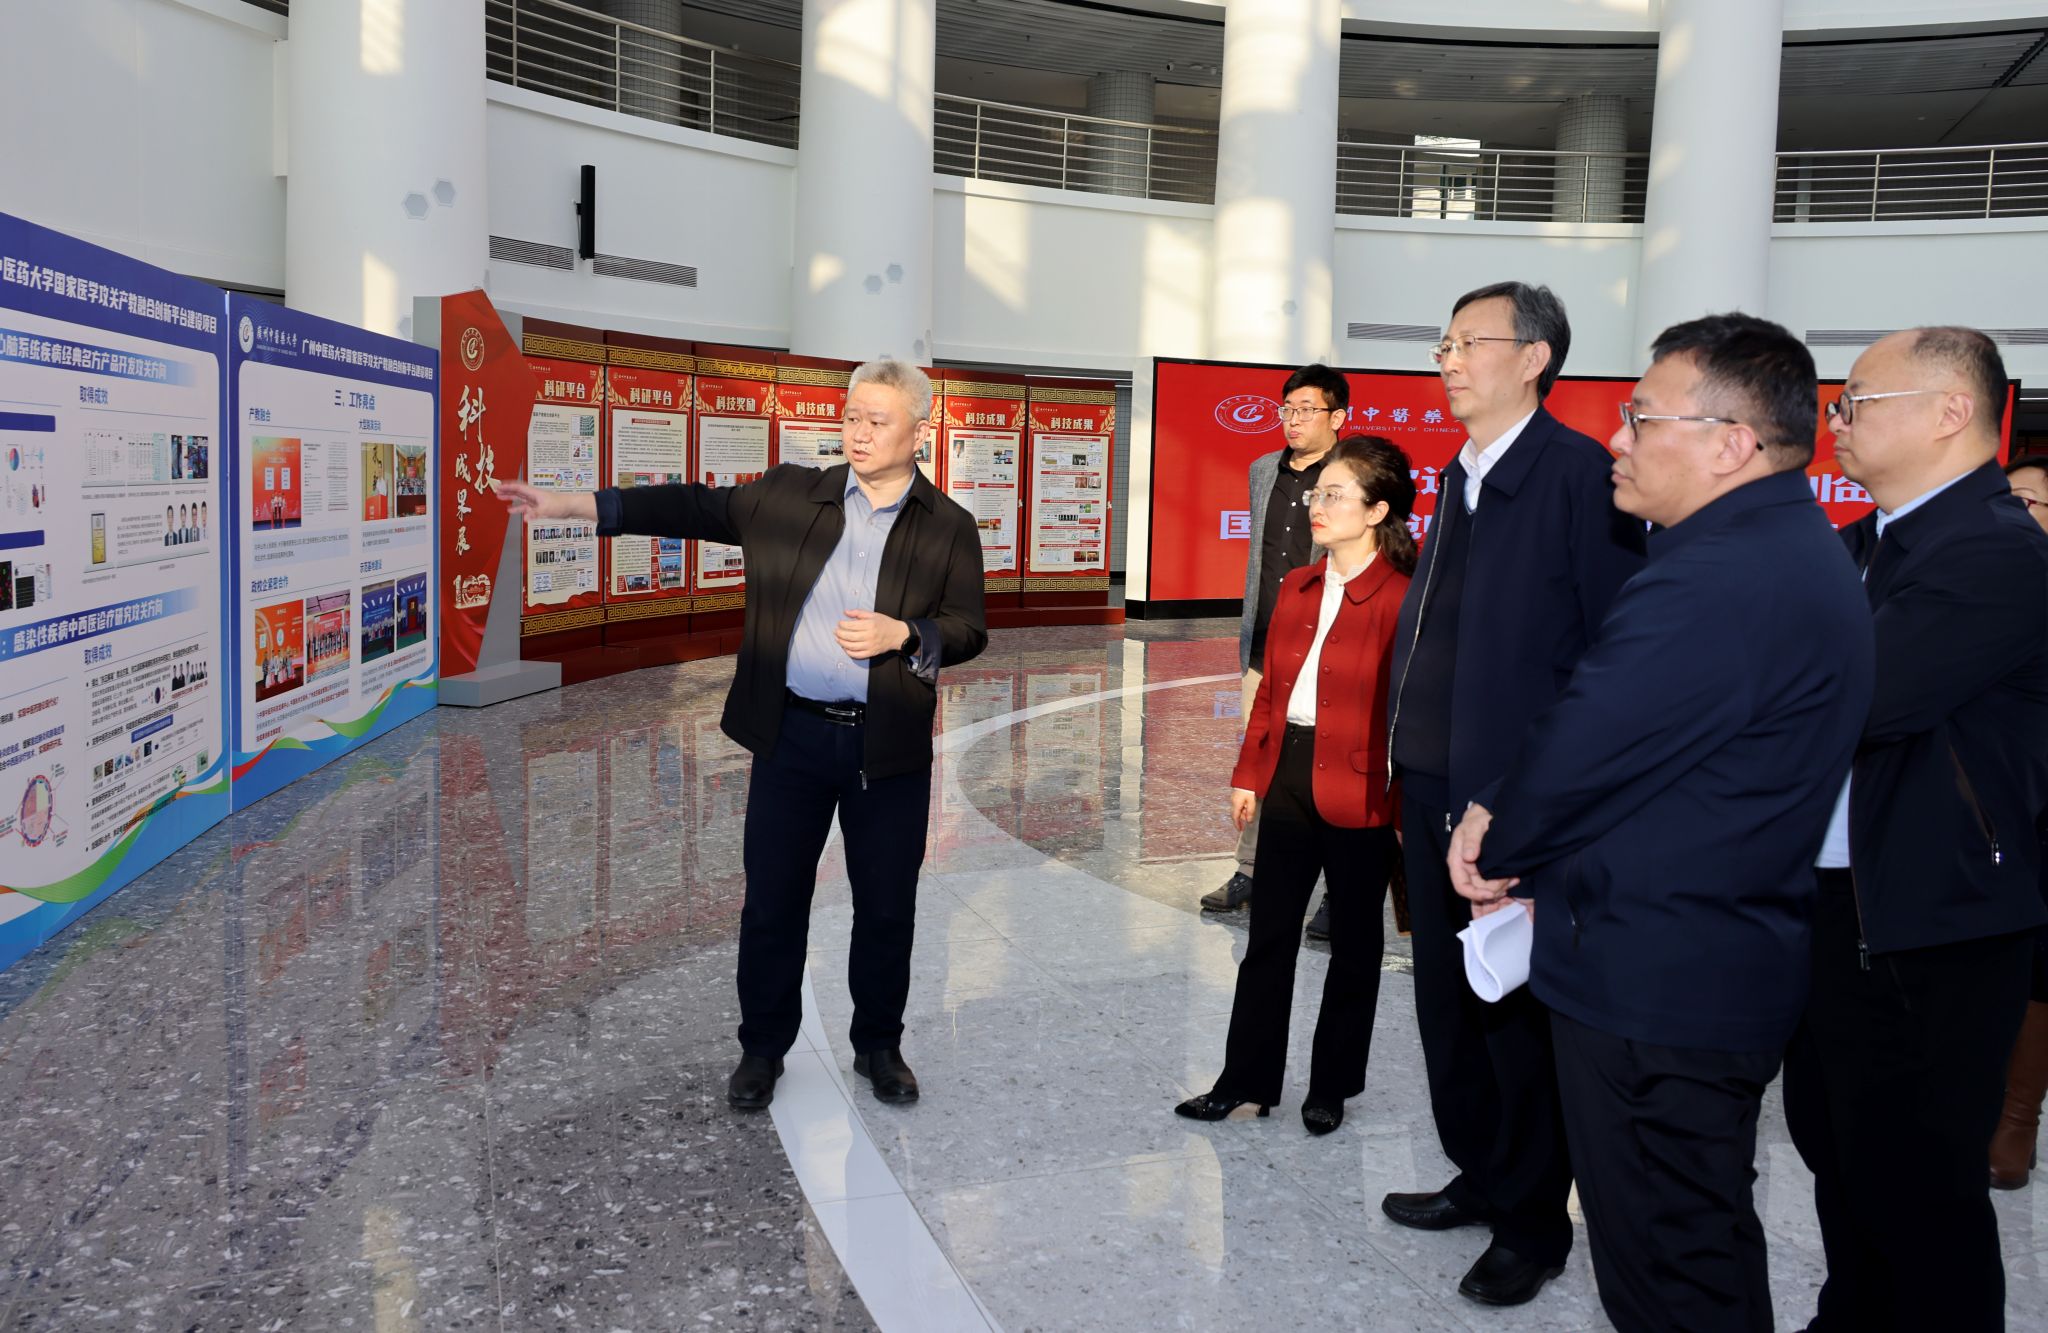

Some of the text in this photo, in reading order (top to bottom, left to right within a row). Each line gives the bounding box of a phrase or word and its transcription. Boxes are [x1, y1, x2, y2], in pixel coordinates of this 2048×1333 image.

[0, 256, 217, 334] 医药大学国家医学攻关产教融合创新平台建设项目
[544, 379, 585, 400] 科研平台
[630, 387, 672, 406] 科研平台
[716, 395, 756, 412] 科技奖励
[795, 401, 836, 417] 科技成果
[965, 412, 1006, 426] 科技成果
[1347, 405, 1460, 424] 中醫藥
[1051, 417, 1094, 431] 科技成果
